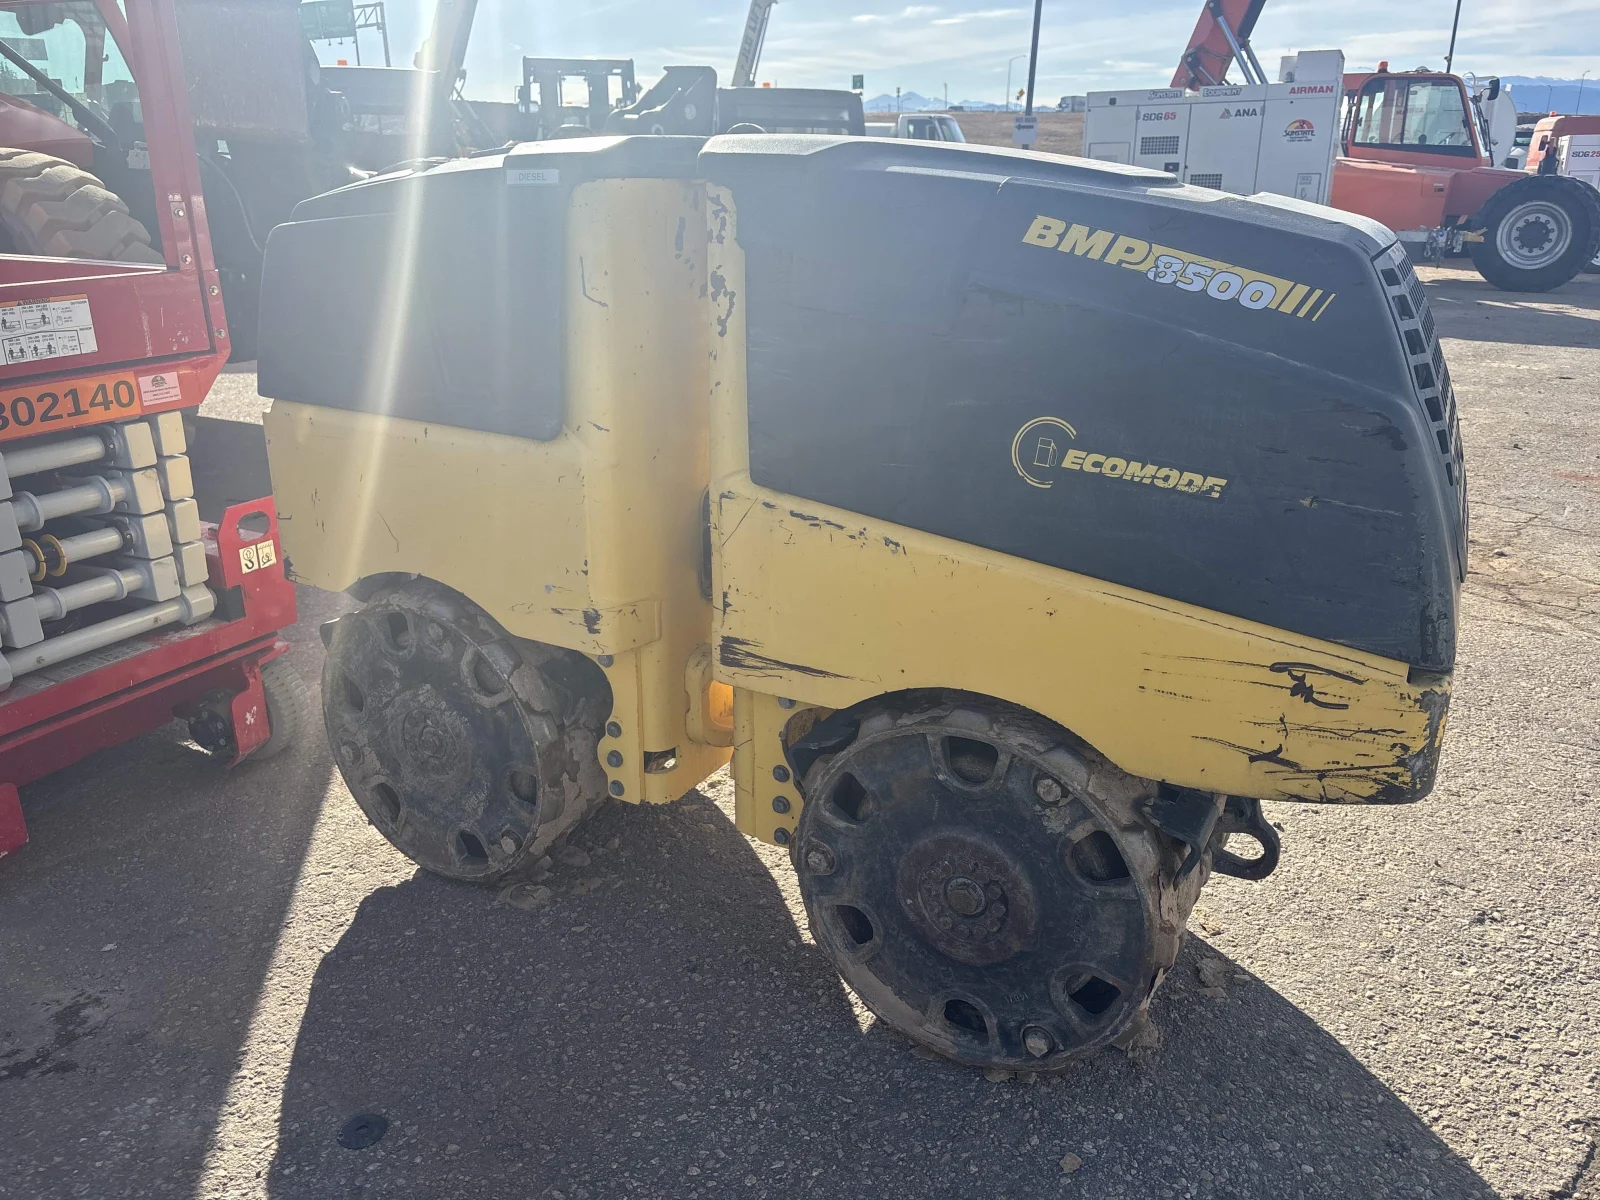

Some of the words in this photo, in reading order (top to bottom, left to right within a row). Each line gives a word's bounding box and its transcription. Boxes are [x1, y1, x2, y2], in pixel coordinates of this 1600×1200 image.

[1289, 86, 1334, 95] AIRMAN
[1234, 108, 1258, 117] ANA
[518, 172, 547, 181] DIESEL
[1022, 215, 1150, 265] BMP
[1146, 254, 1277, 310] 8500
[1061, 448, 1228, 499] ECOMODE
